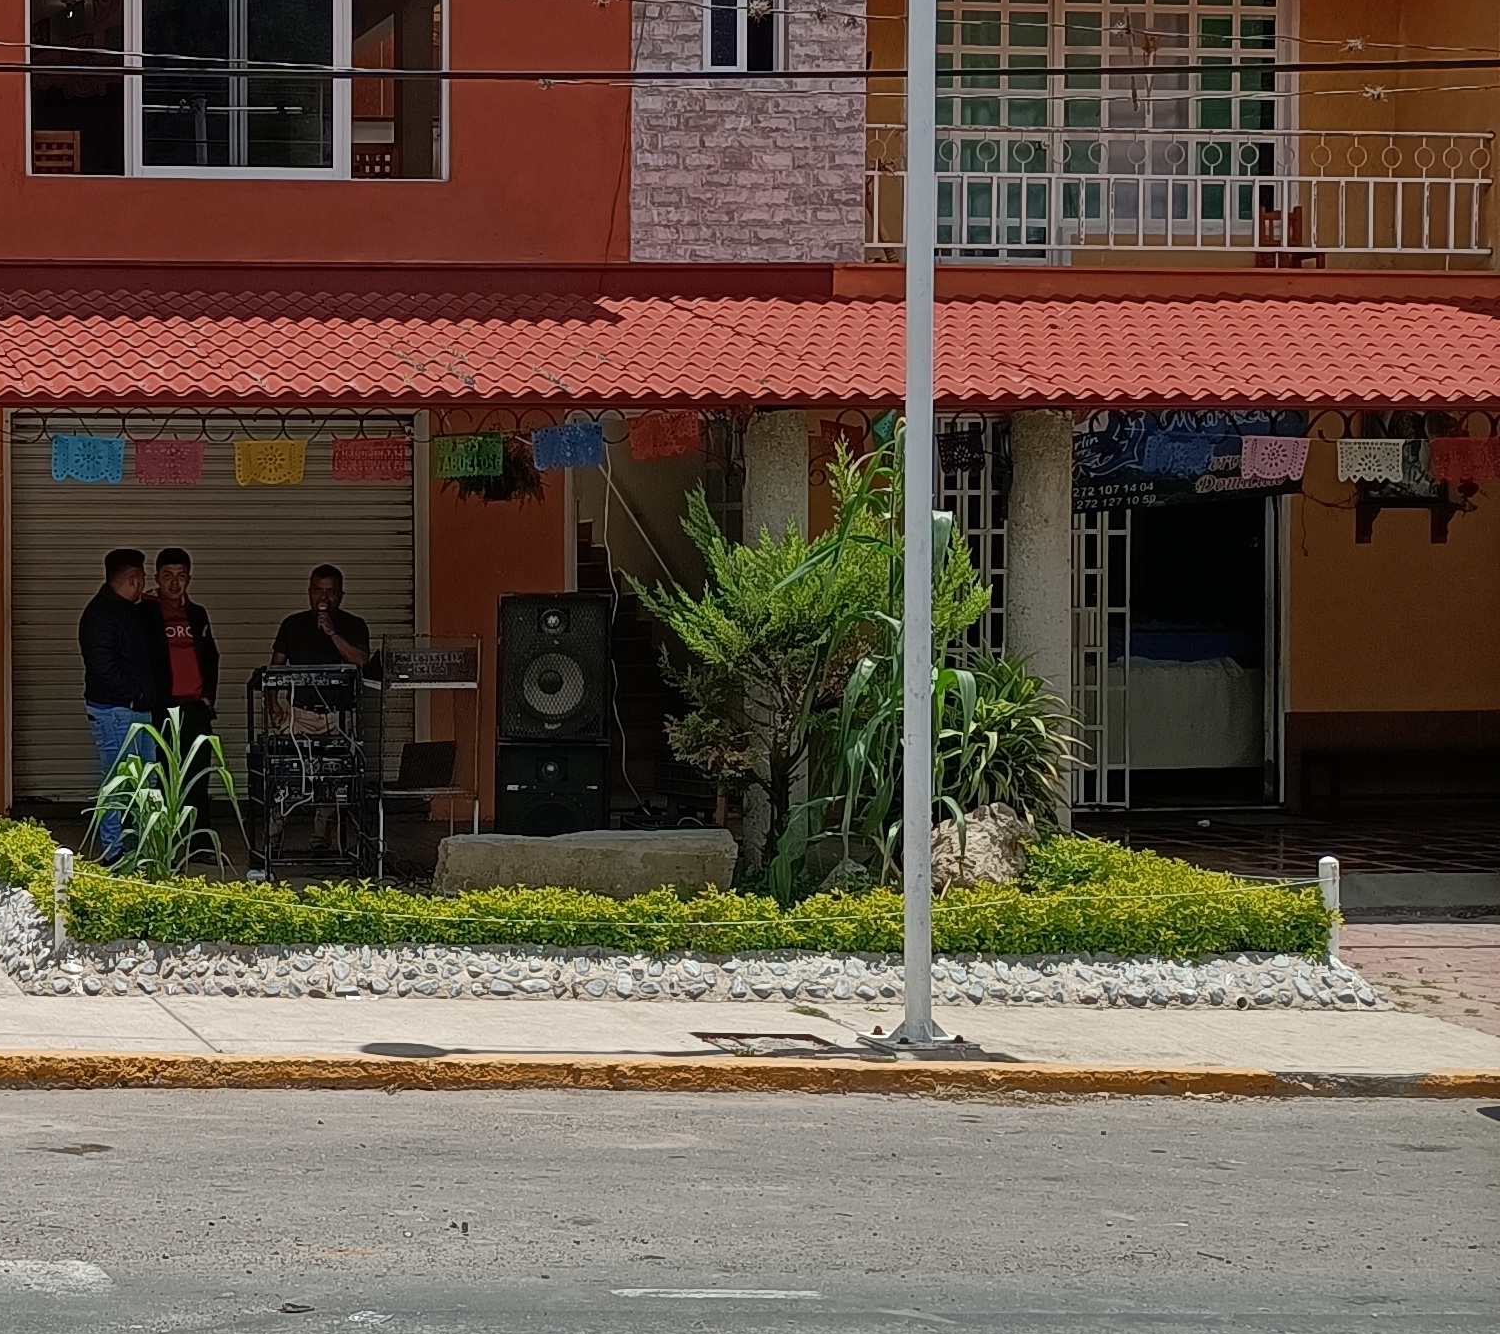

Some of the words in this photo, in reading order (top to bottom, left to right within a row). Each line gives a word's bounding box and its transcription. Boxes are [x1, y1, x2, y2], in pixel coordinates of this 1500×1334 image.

[1072, 486, 1096, 498] 272
[1098, 484, 1120, 496] 107
[1123, 483, 1137, 494] 14
[1139, 481, 1154, 493] 04
[1102, 496, 1123, 508] 127
[1126, 495, 1140, 506] 10
[1142, 493, 1157, 505] 59
